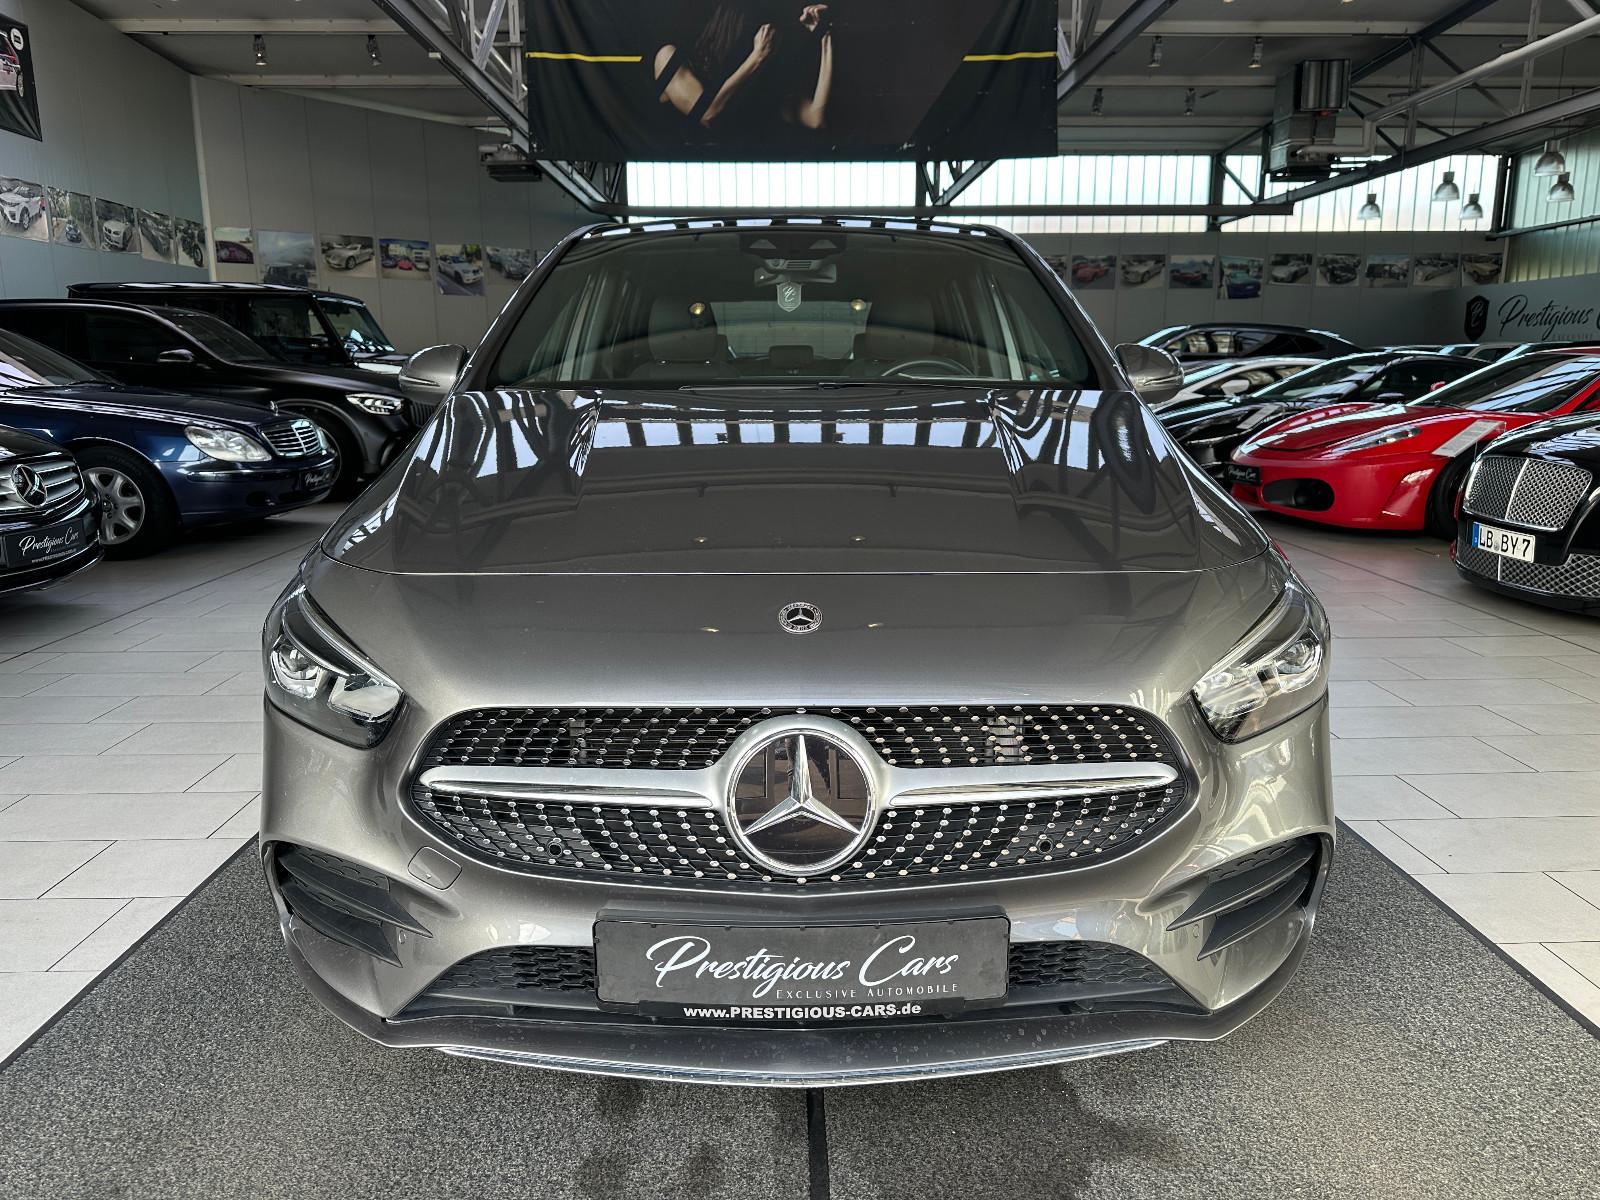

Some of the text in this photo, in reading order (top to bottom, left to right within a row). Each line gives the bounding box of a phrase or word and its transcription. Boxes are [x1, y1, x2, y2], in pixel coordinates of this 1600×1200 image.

[1498, 294, 1594, 341] Prestigious
[19, 535, 65, 556] Prestigious
[1480, 527, 1531, 557] LB BY 7
[646, 935, 959, 999] Prestigious Cars
[776, 983, 958, 999] EXCLUSIVE AUTOMOBILE
[683, 1003, 922, 1019] www.PRESTIGIOUS-CARS.de
